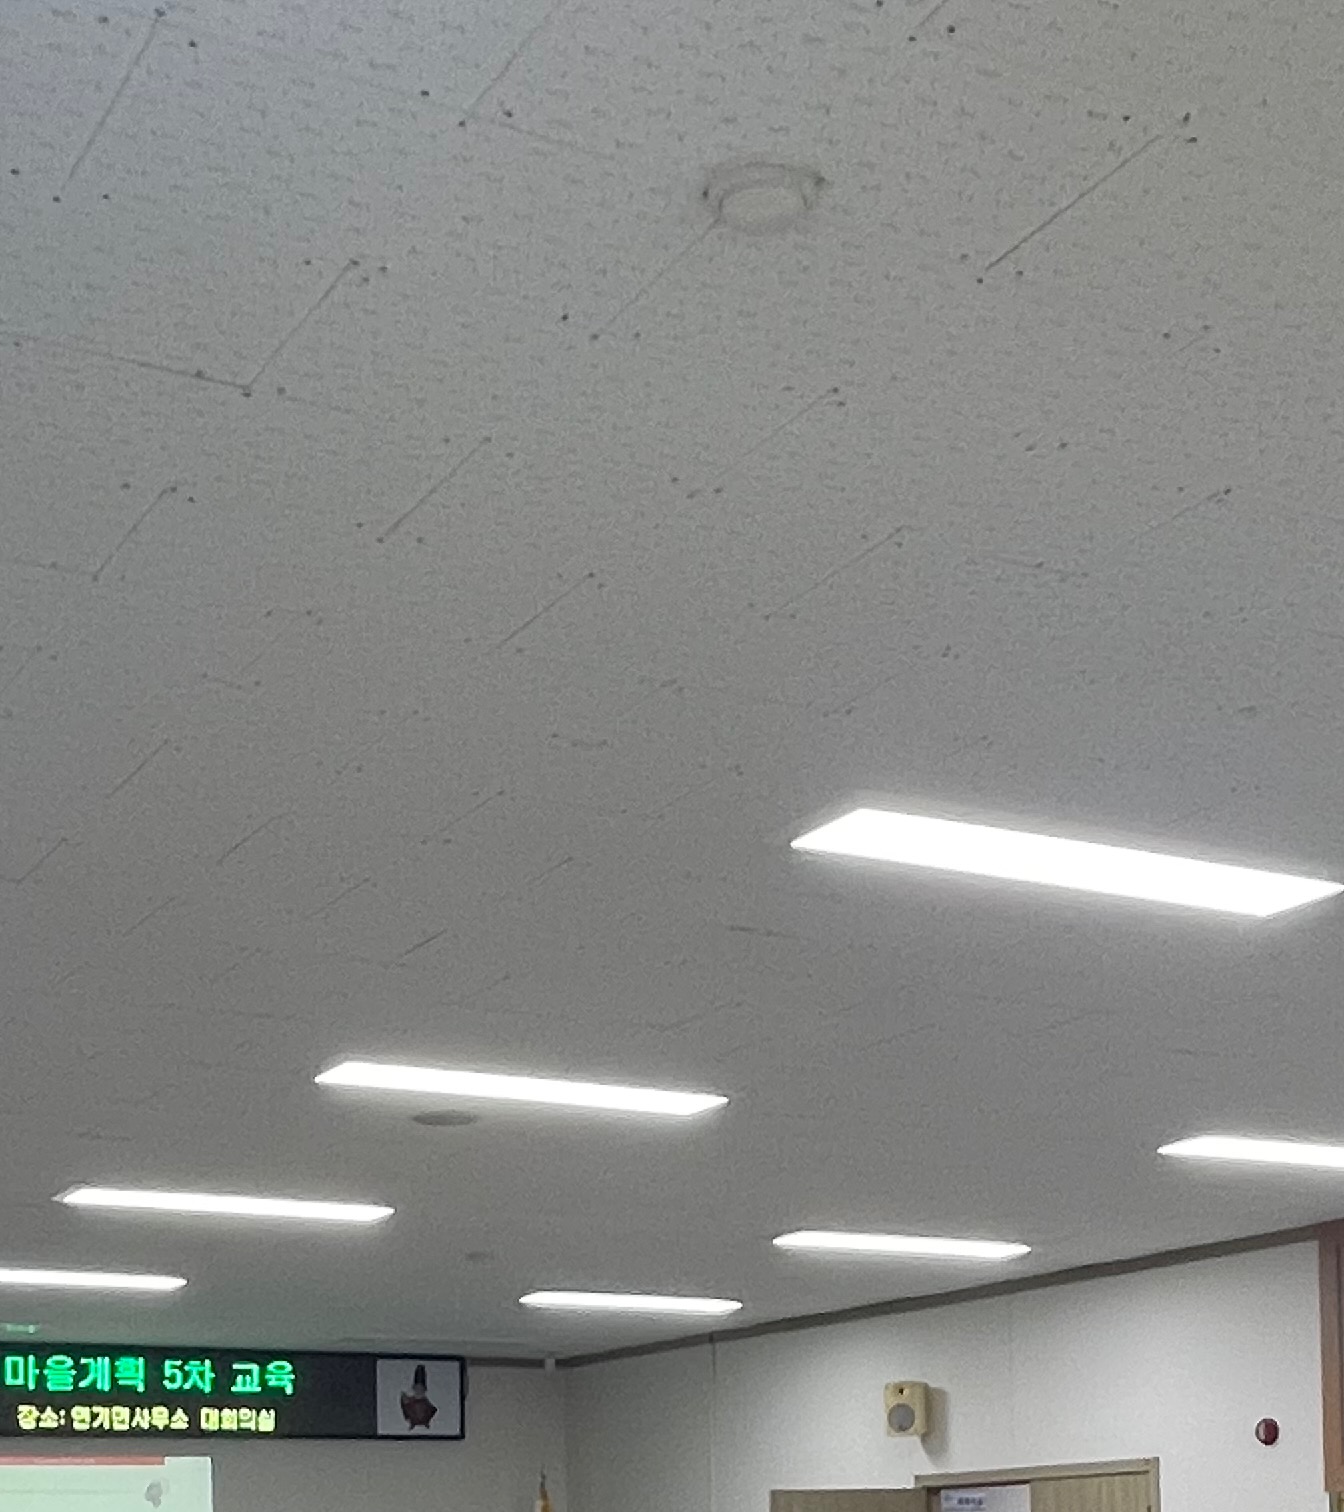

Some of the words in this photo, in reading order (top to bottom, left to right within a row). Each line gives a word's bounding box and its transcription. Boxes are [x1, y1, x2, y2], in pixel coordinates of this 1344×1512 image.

[4, 1354, 147, 1393] 마을계획
[162, 1357, 216, 1394] 5차
[229, 1359, 296, 1395] 교육
[16, 1403, 66, 1431] 장소:
[70, 1404, 190, 1431] 연기면사무소
